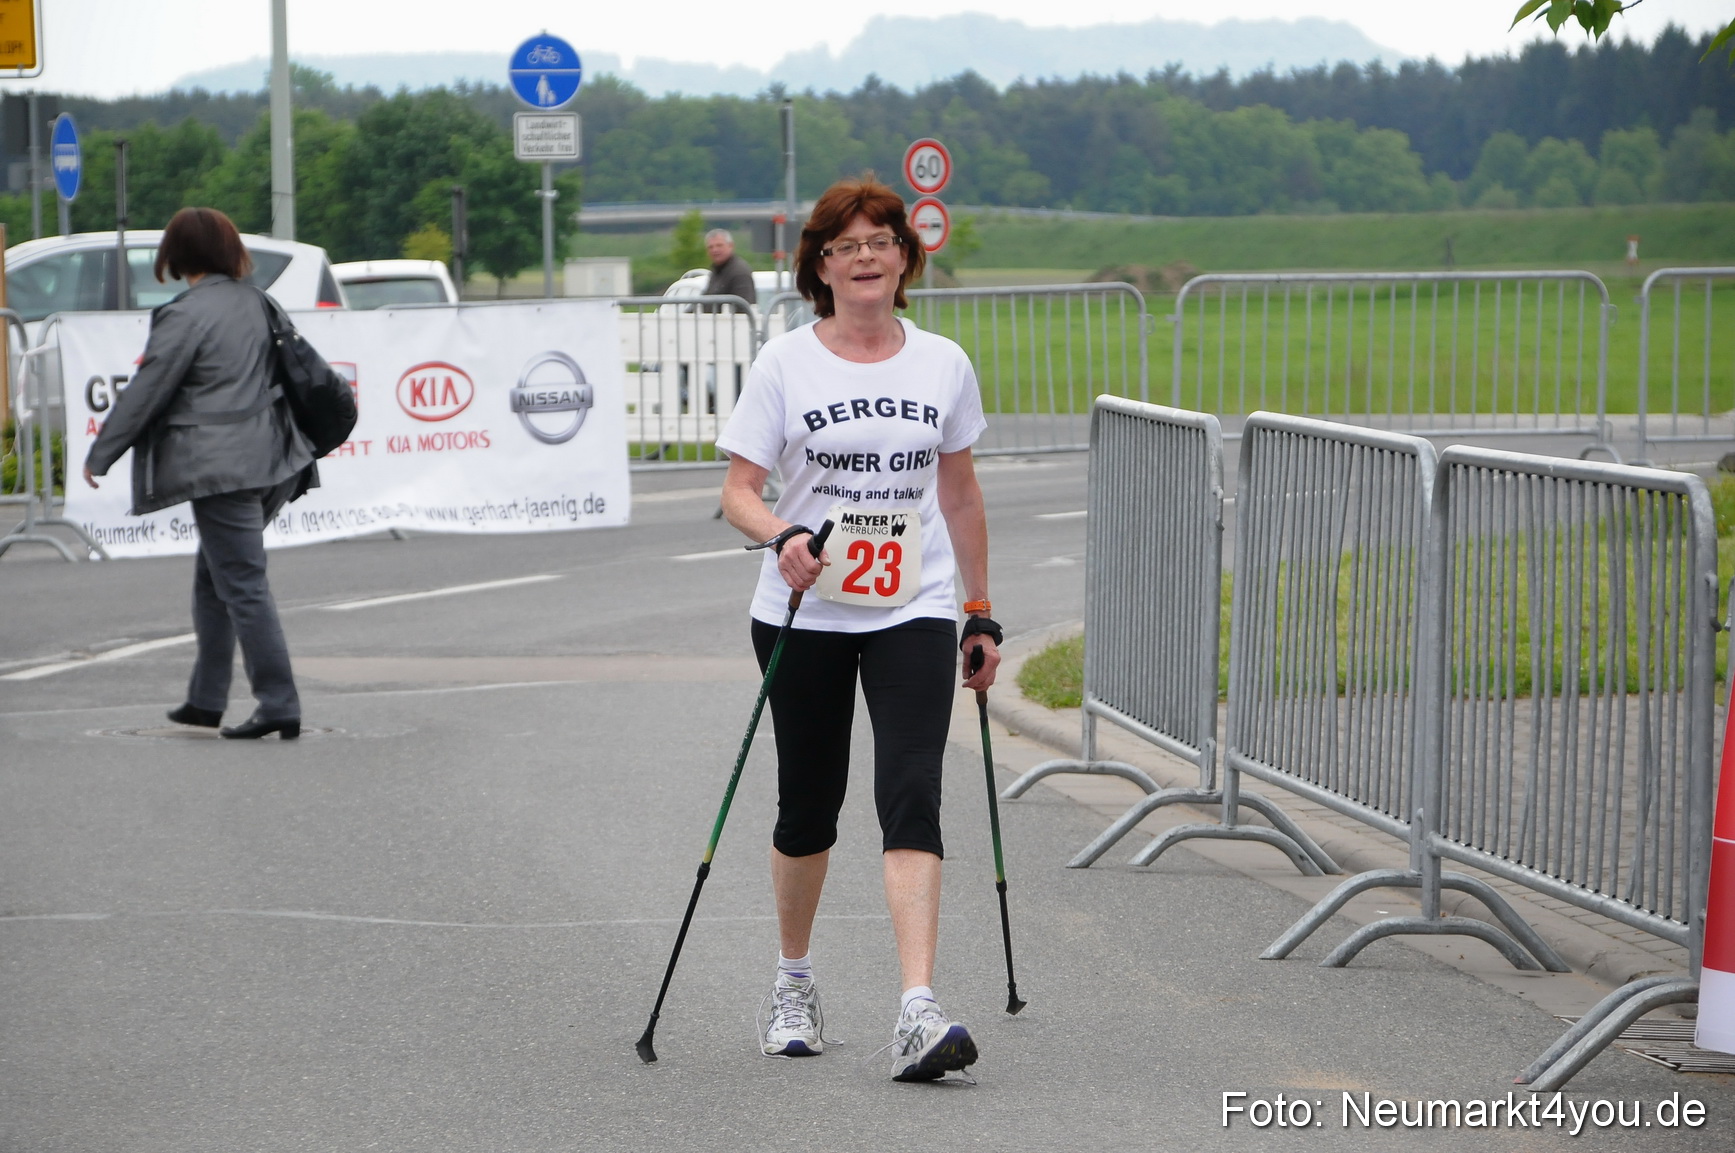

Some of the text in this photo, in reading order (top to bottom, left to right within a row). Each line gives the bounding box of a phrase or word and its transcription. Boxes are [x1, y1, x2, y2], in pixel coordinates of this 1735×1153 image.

[915, 155, 941, 178] 60
[410, 376, 460, 408] KIA
[519, 390, 586, 407] NISSAN
[802, 397, 939, 432] BERGER
[386, 430, 491, 454] KIA MOTORS
[805, 446, 881, 472] POWER
[811, 484, 861, 502] walking
[865, 488, 890, 500] and
[840, 524, 889, 535] WERBUNG
[841, 512, 888, 526] MEYER
[83, 519, 156, 545] Neumarkt
[841, 539, 902, 597] 23
